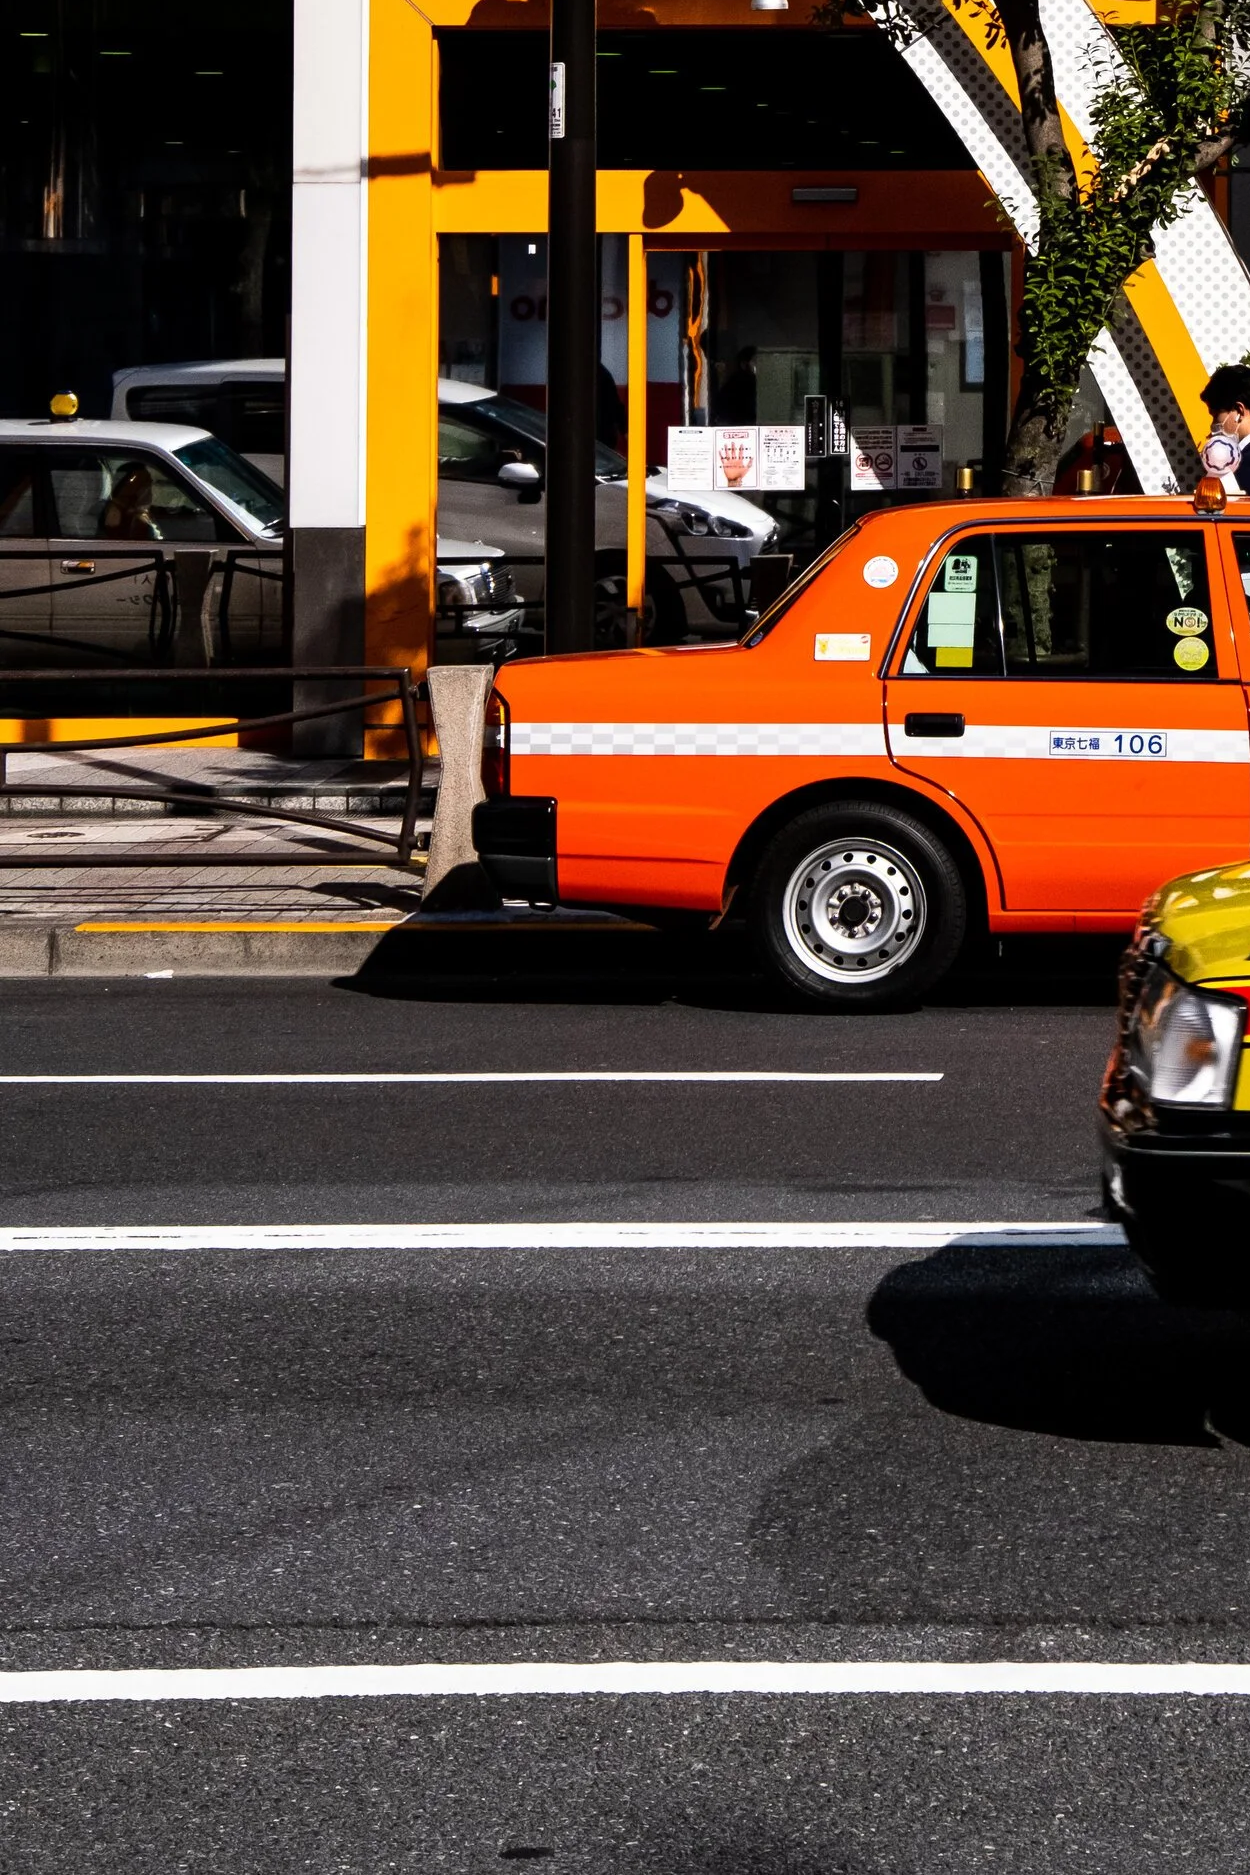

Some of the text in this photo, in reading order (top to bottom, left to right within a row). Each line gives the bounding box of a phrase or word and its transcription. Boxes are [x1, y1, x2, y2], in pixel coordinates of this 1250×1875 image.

[1052, 734, 1163, 755] 東京七福 106
